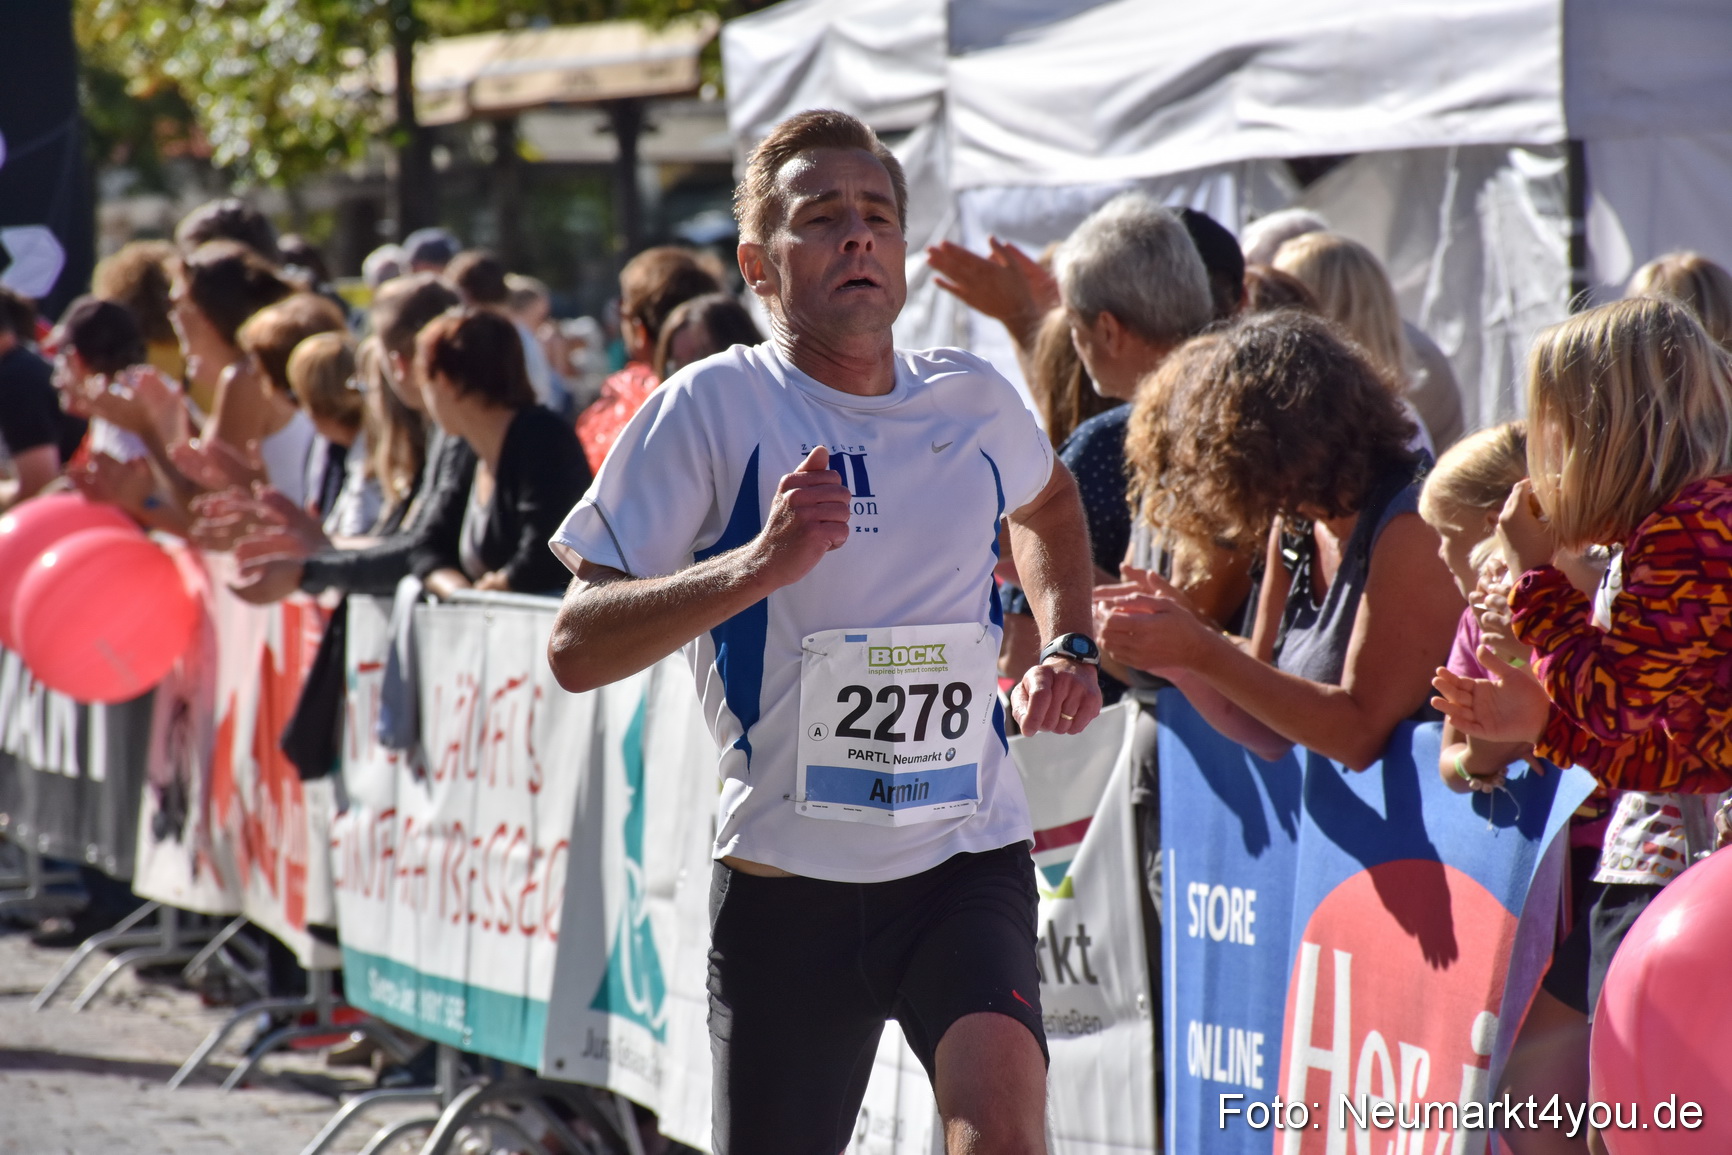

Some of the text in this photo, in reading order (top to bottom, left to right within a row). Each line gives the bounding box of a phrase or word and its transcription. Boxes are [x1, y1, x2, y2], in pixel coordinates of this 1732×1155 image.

[869, 644, 948, 667] BOCK
[896, 667, 903, 675] by
[921, 665, 949, 673] concepts
[834, 682, 973, 743] 2278
[813, 727, 822, 737] A
[847, 748, 890, 764] PARTL
[893, 751, 942, 765] Neumarkt
[869, 777, 930, 804] Armin
[1188, 881, 1256, 946] STORE
[1188, 1020, 1264, 1090] ONLINE
